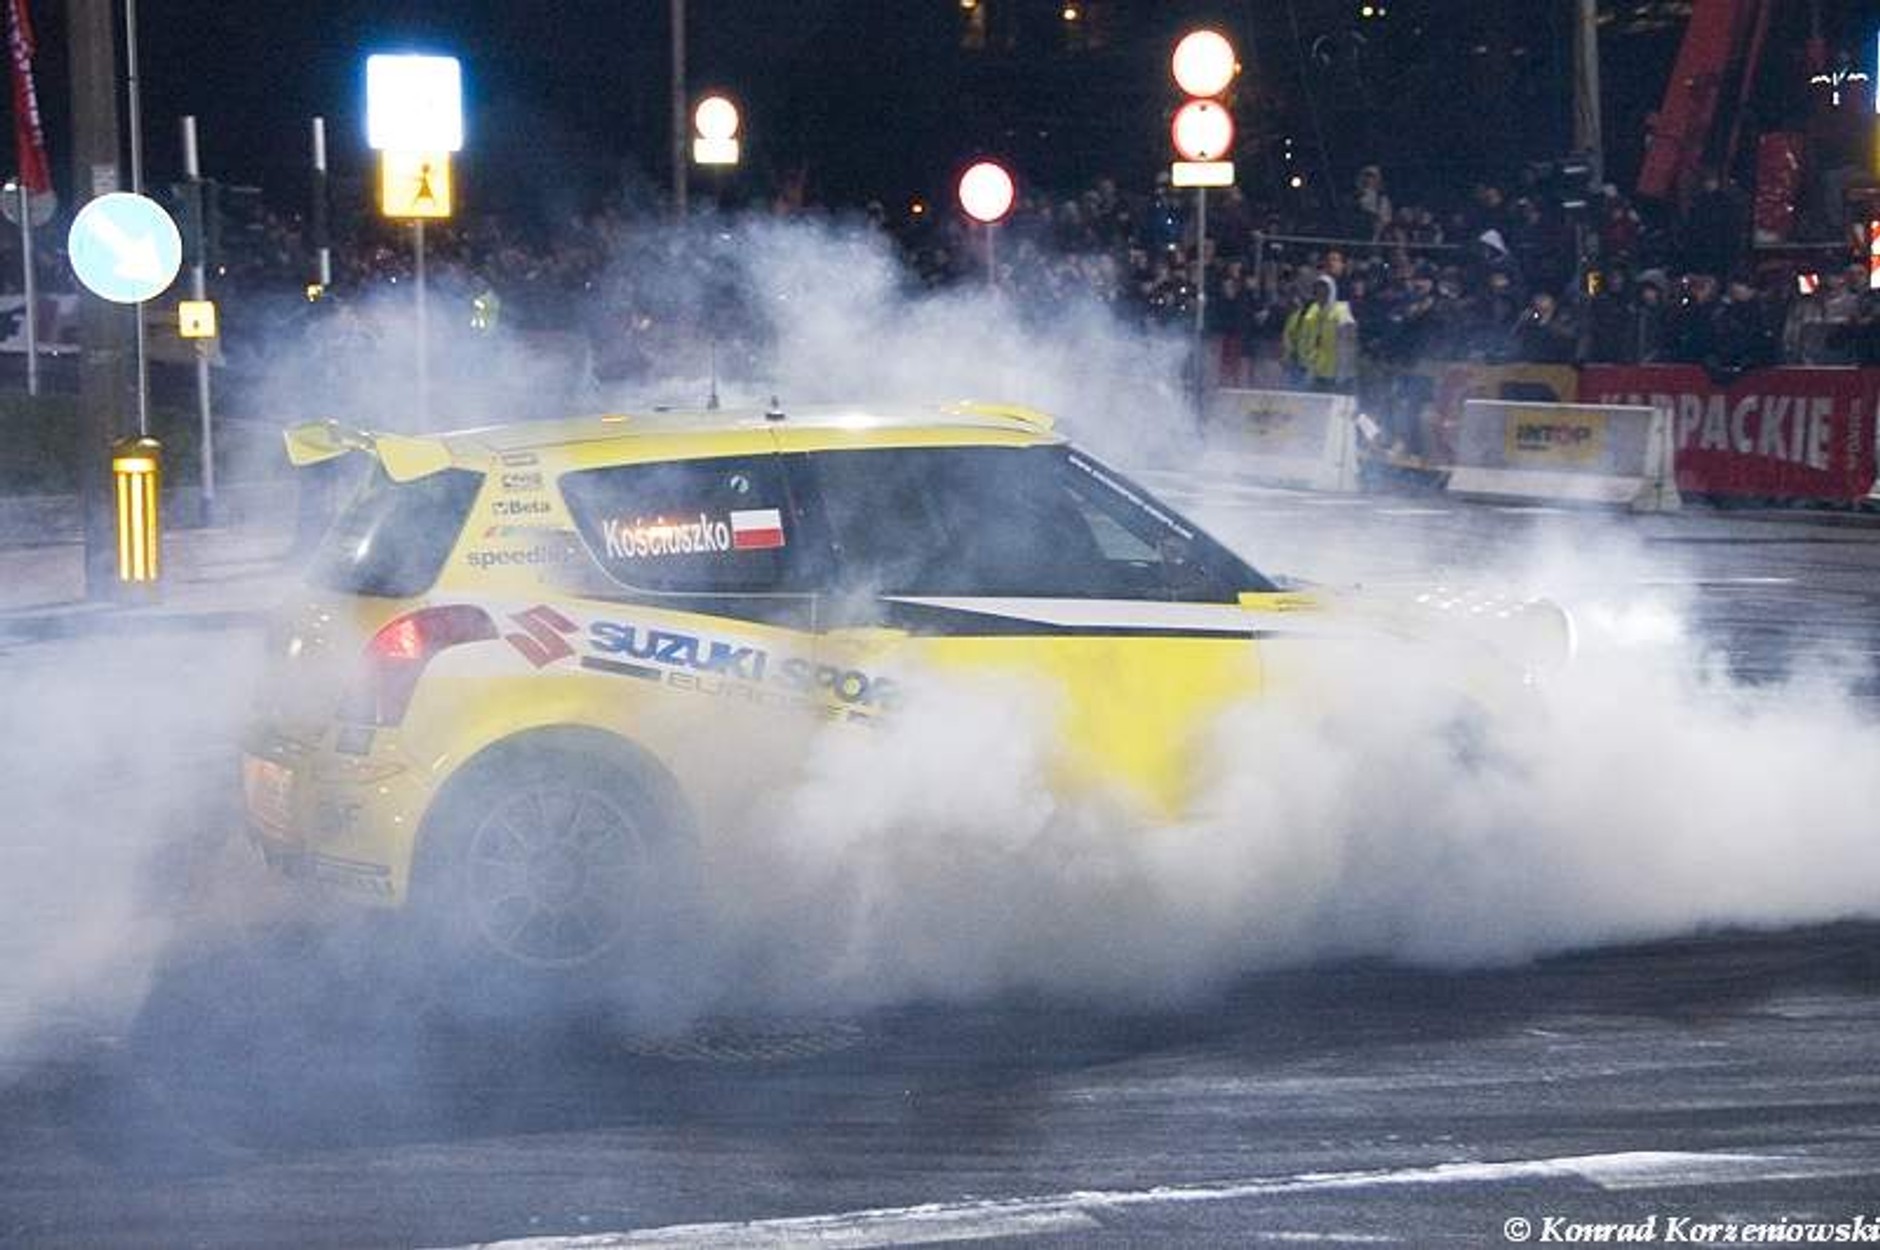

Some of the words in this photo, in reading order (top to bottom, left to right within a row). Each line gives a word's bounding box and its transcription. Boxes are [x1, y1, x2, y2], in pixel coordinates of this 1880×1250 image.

[1600, 393, 1836, 471] PACKIE
[602, 512, 731, 558] Kościuszko
[588, 620, 766, 681] SUZUKI
